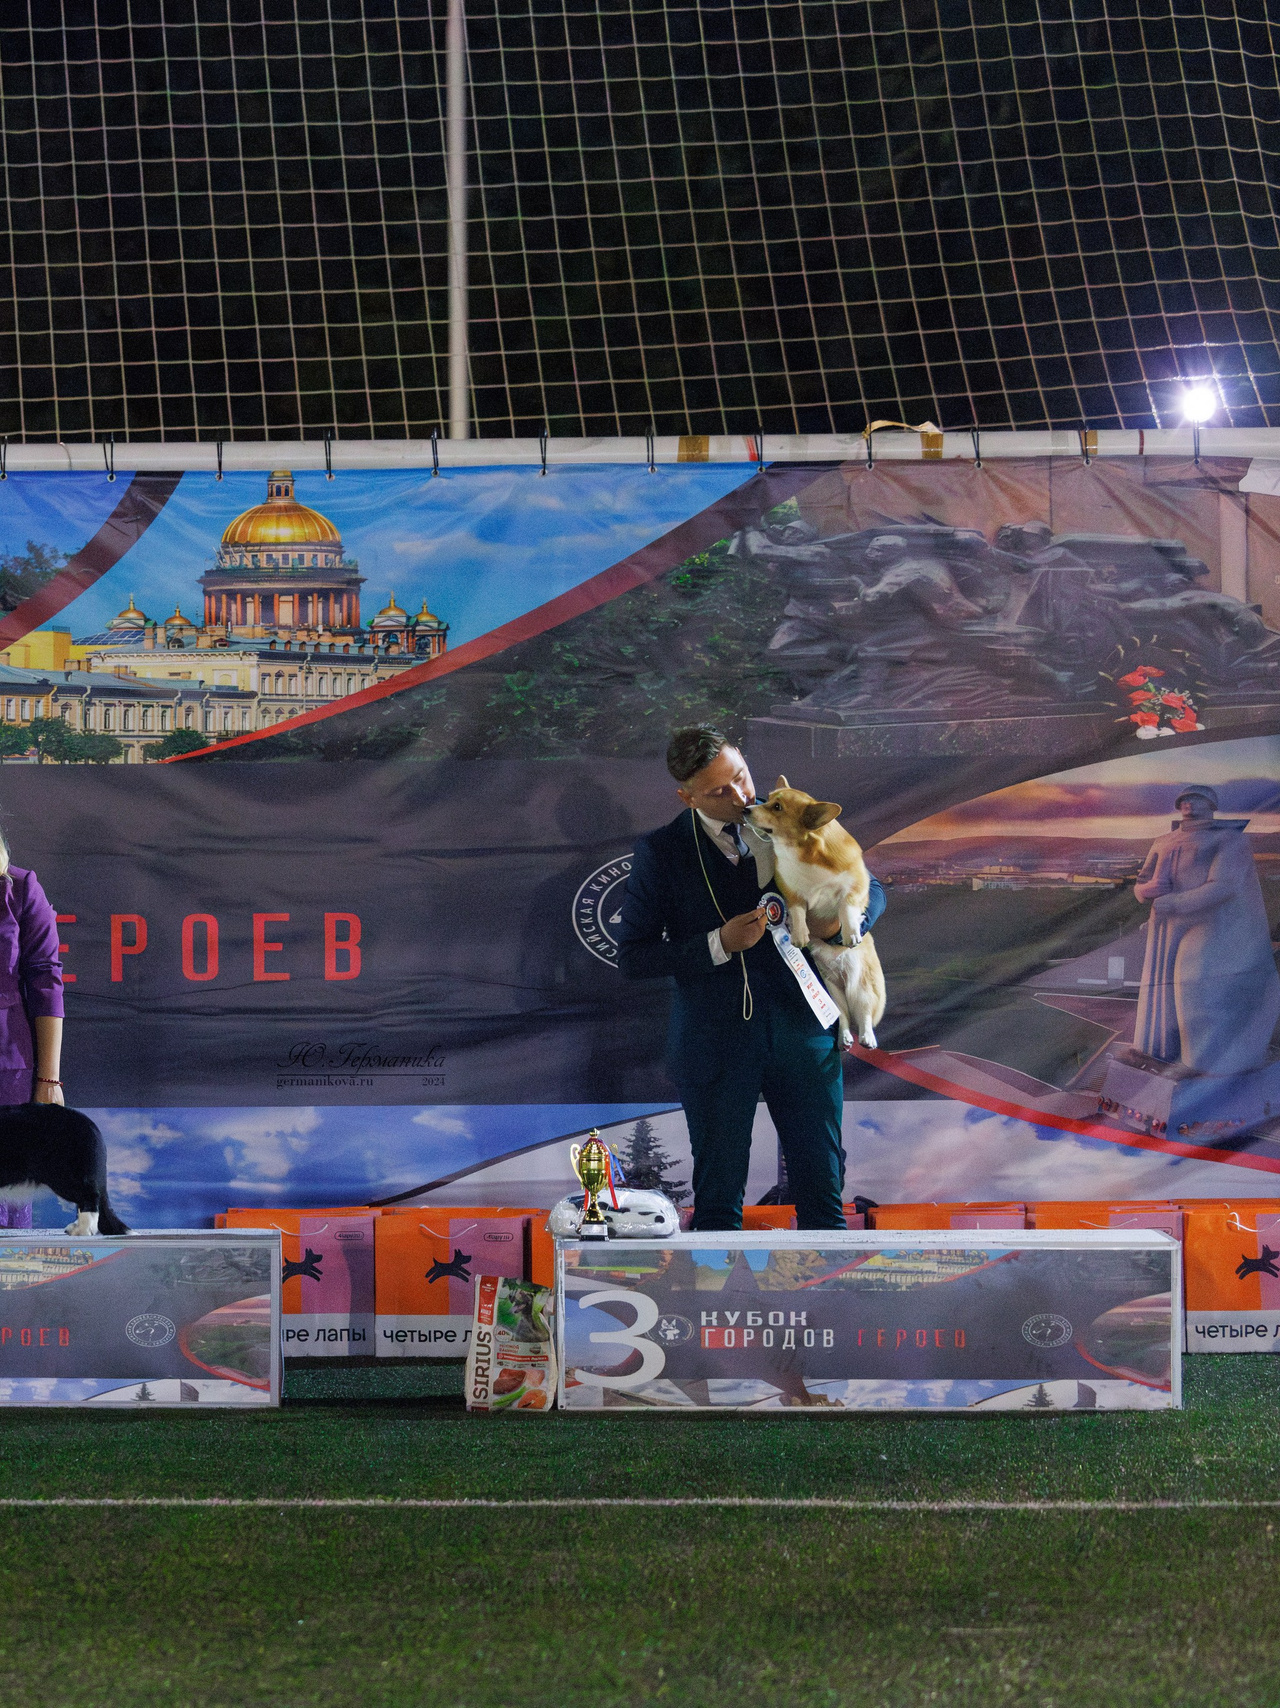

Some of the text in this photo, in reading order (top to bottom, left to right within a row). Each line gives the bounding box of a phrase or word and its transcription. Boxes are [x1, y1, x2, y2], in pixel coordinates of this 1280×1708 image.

[589, 861, 632, 892] КИНО
[55, 912, 362, 983] ЕРОЕВ
[701, 1311, 807, 1326] КУБОК
[314, 1326, 367, 1343] лапы
[383, 1329, 457, 1343] четыре
[574, 1291, 666, 1388] 3
[705, 1328, 834, 1350] ГОРОДОВ
[1195, 1324, 1268, 1339] четыре
[472, 1330, 492, 1400] SIRIUS
